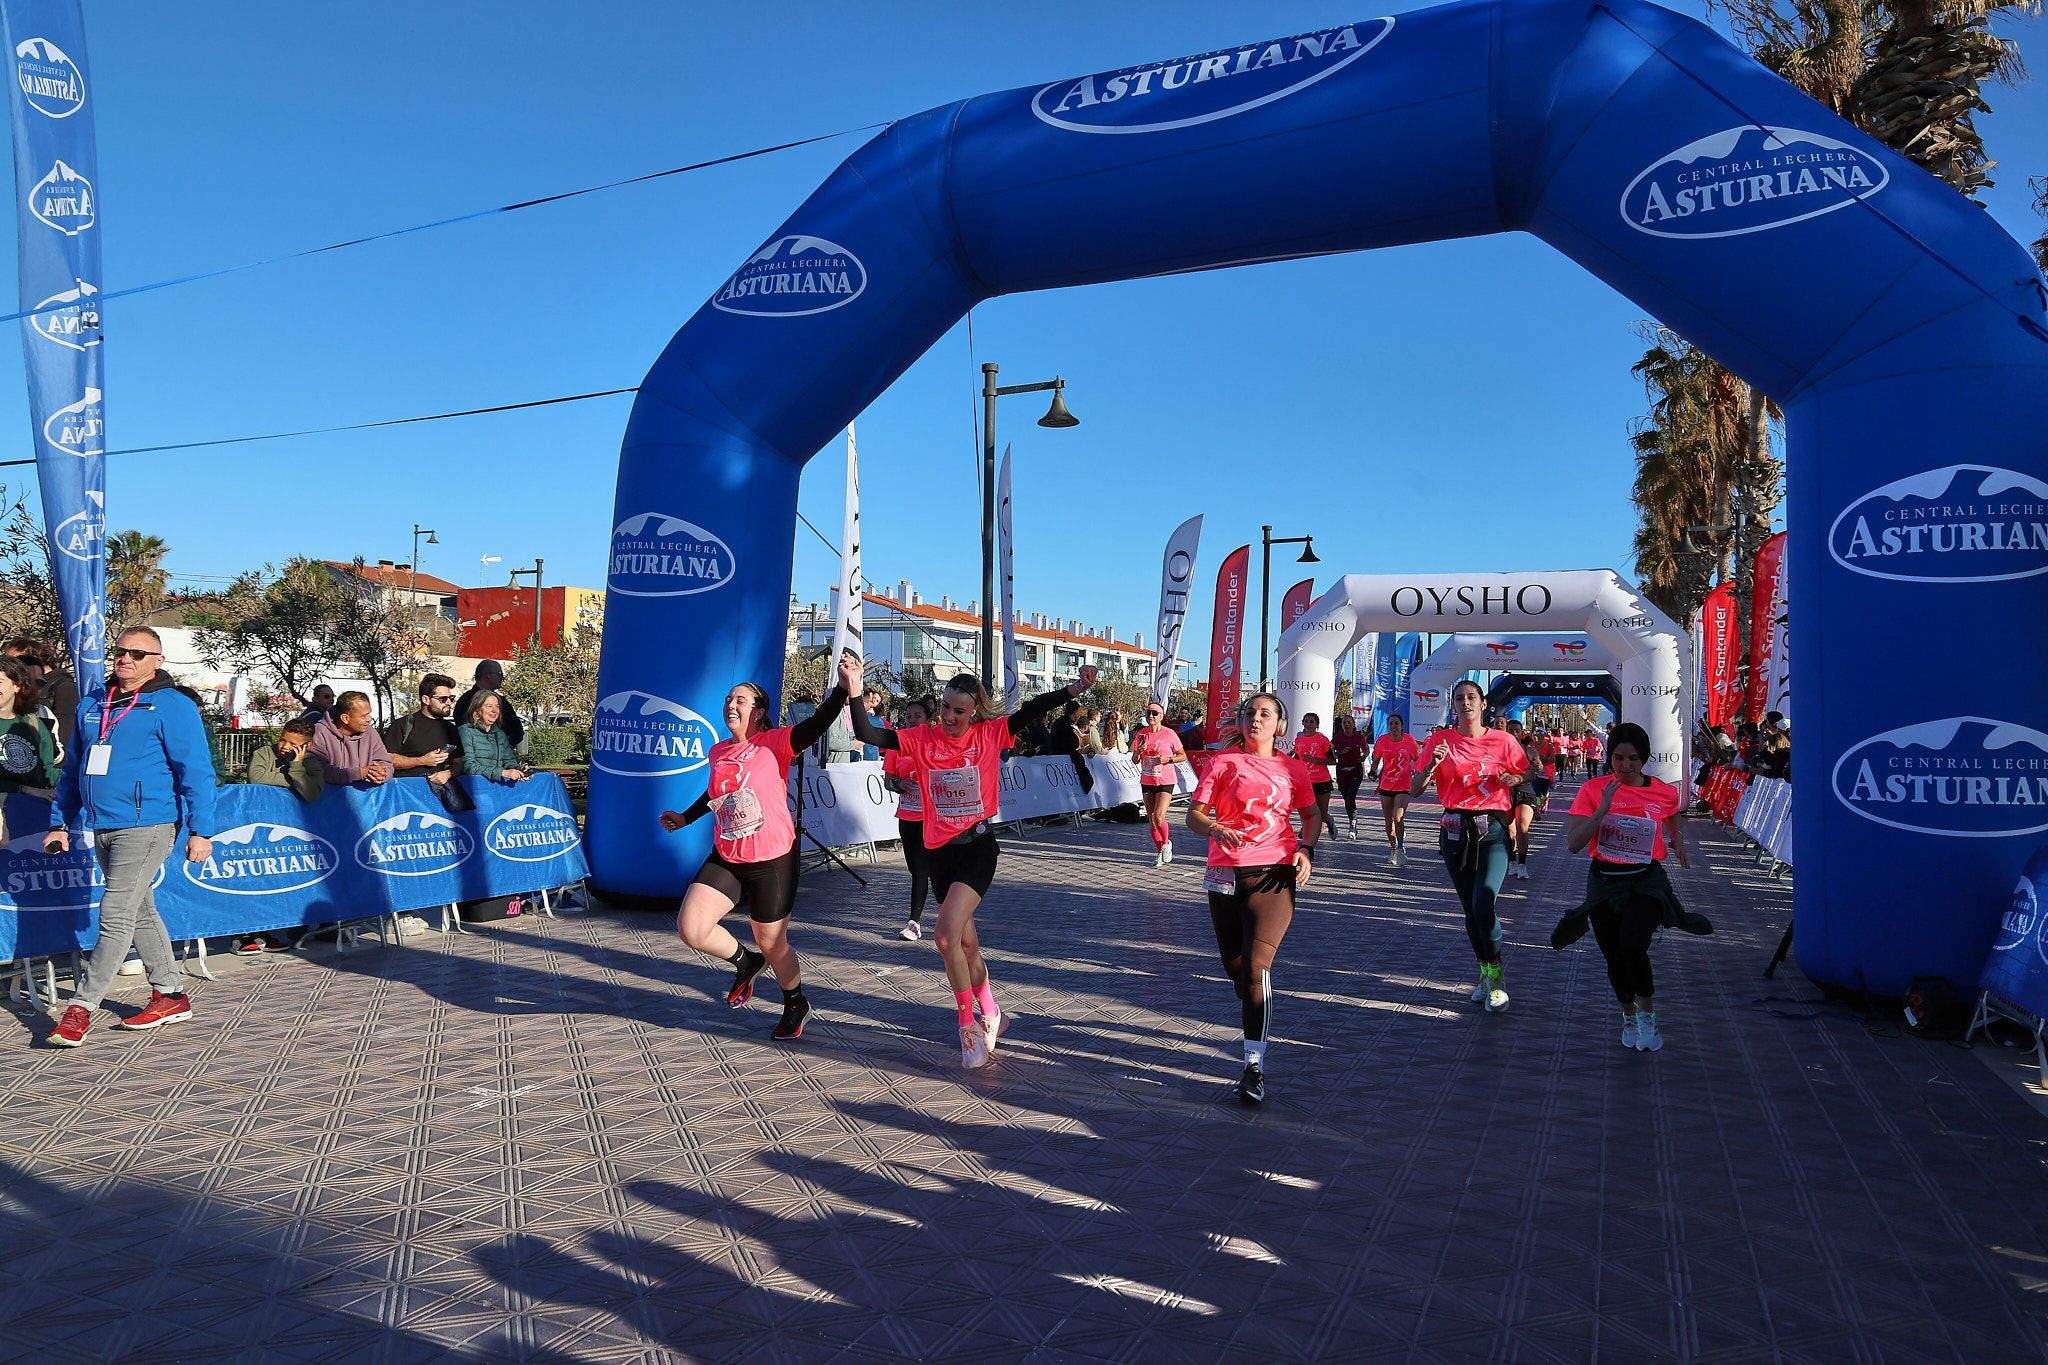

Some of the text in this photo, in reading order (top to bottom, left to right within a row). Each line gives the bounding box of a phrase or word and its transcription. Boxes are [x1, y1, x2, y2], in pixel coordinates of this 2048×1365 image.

[1053, 24, 1362, 114] ASTURIANA
[1677, 152, 1857, 184] CENTRAL LECHERA
[1640, 165, 1874, 225] ASTURIANA
[743, 258, 847, 276] CENTRAL LECHERA
[717, 271, 853, 302] ASTURIANA
[1884, 504, 2045, 521] CENTRAL LECHE
[1844, 515, 2048, 559] ASTURIAN
[617, 540, 718, 555] CENTRAL LECHERA
[1390, 584, 1552, 617] OYSHO
[1222, 571, 1240, 655] Santander
[1300, 621, 1346, 632] OYSHO
[1601, 617, 1654, 629] OYSHO
[1713, 605, 1727, 677] Santander
[1280, 680, 1321, 691] OYSHO
[1523, 681, 1595, 689] VOLVO
[1630, 685, 1681, 696] OYSHO
[600, 717, 701, 733] CENTRAL LECHERA
[1650, 752, 1680, 763] SHO
[1888, 757, 2048, 770] CENTRAL LECHE
[1848, 758, 2048, 805] ASTURIA
[495, 827, 578, 850] ASTURIANA
[221, 843, 322, 857] CENTRAL LECHERA
[366, 838, 469, 865] ASTURIANA
[8, 855, 77, 868] CENTRAL
[197, 853, 331, 880] ASTURIANA
